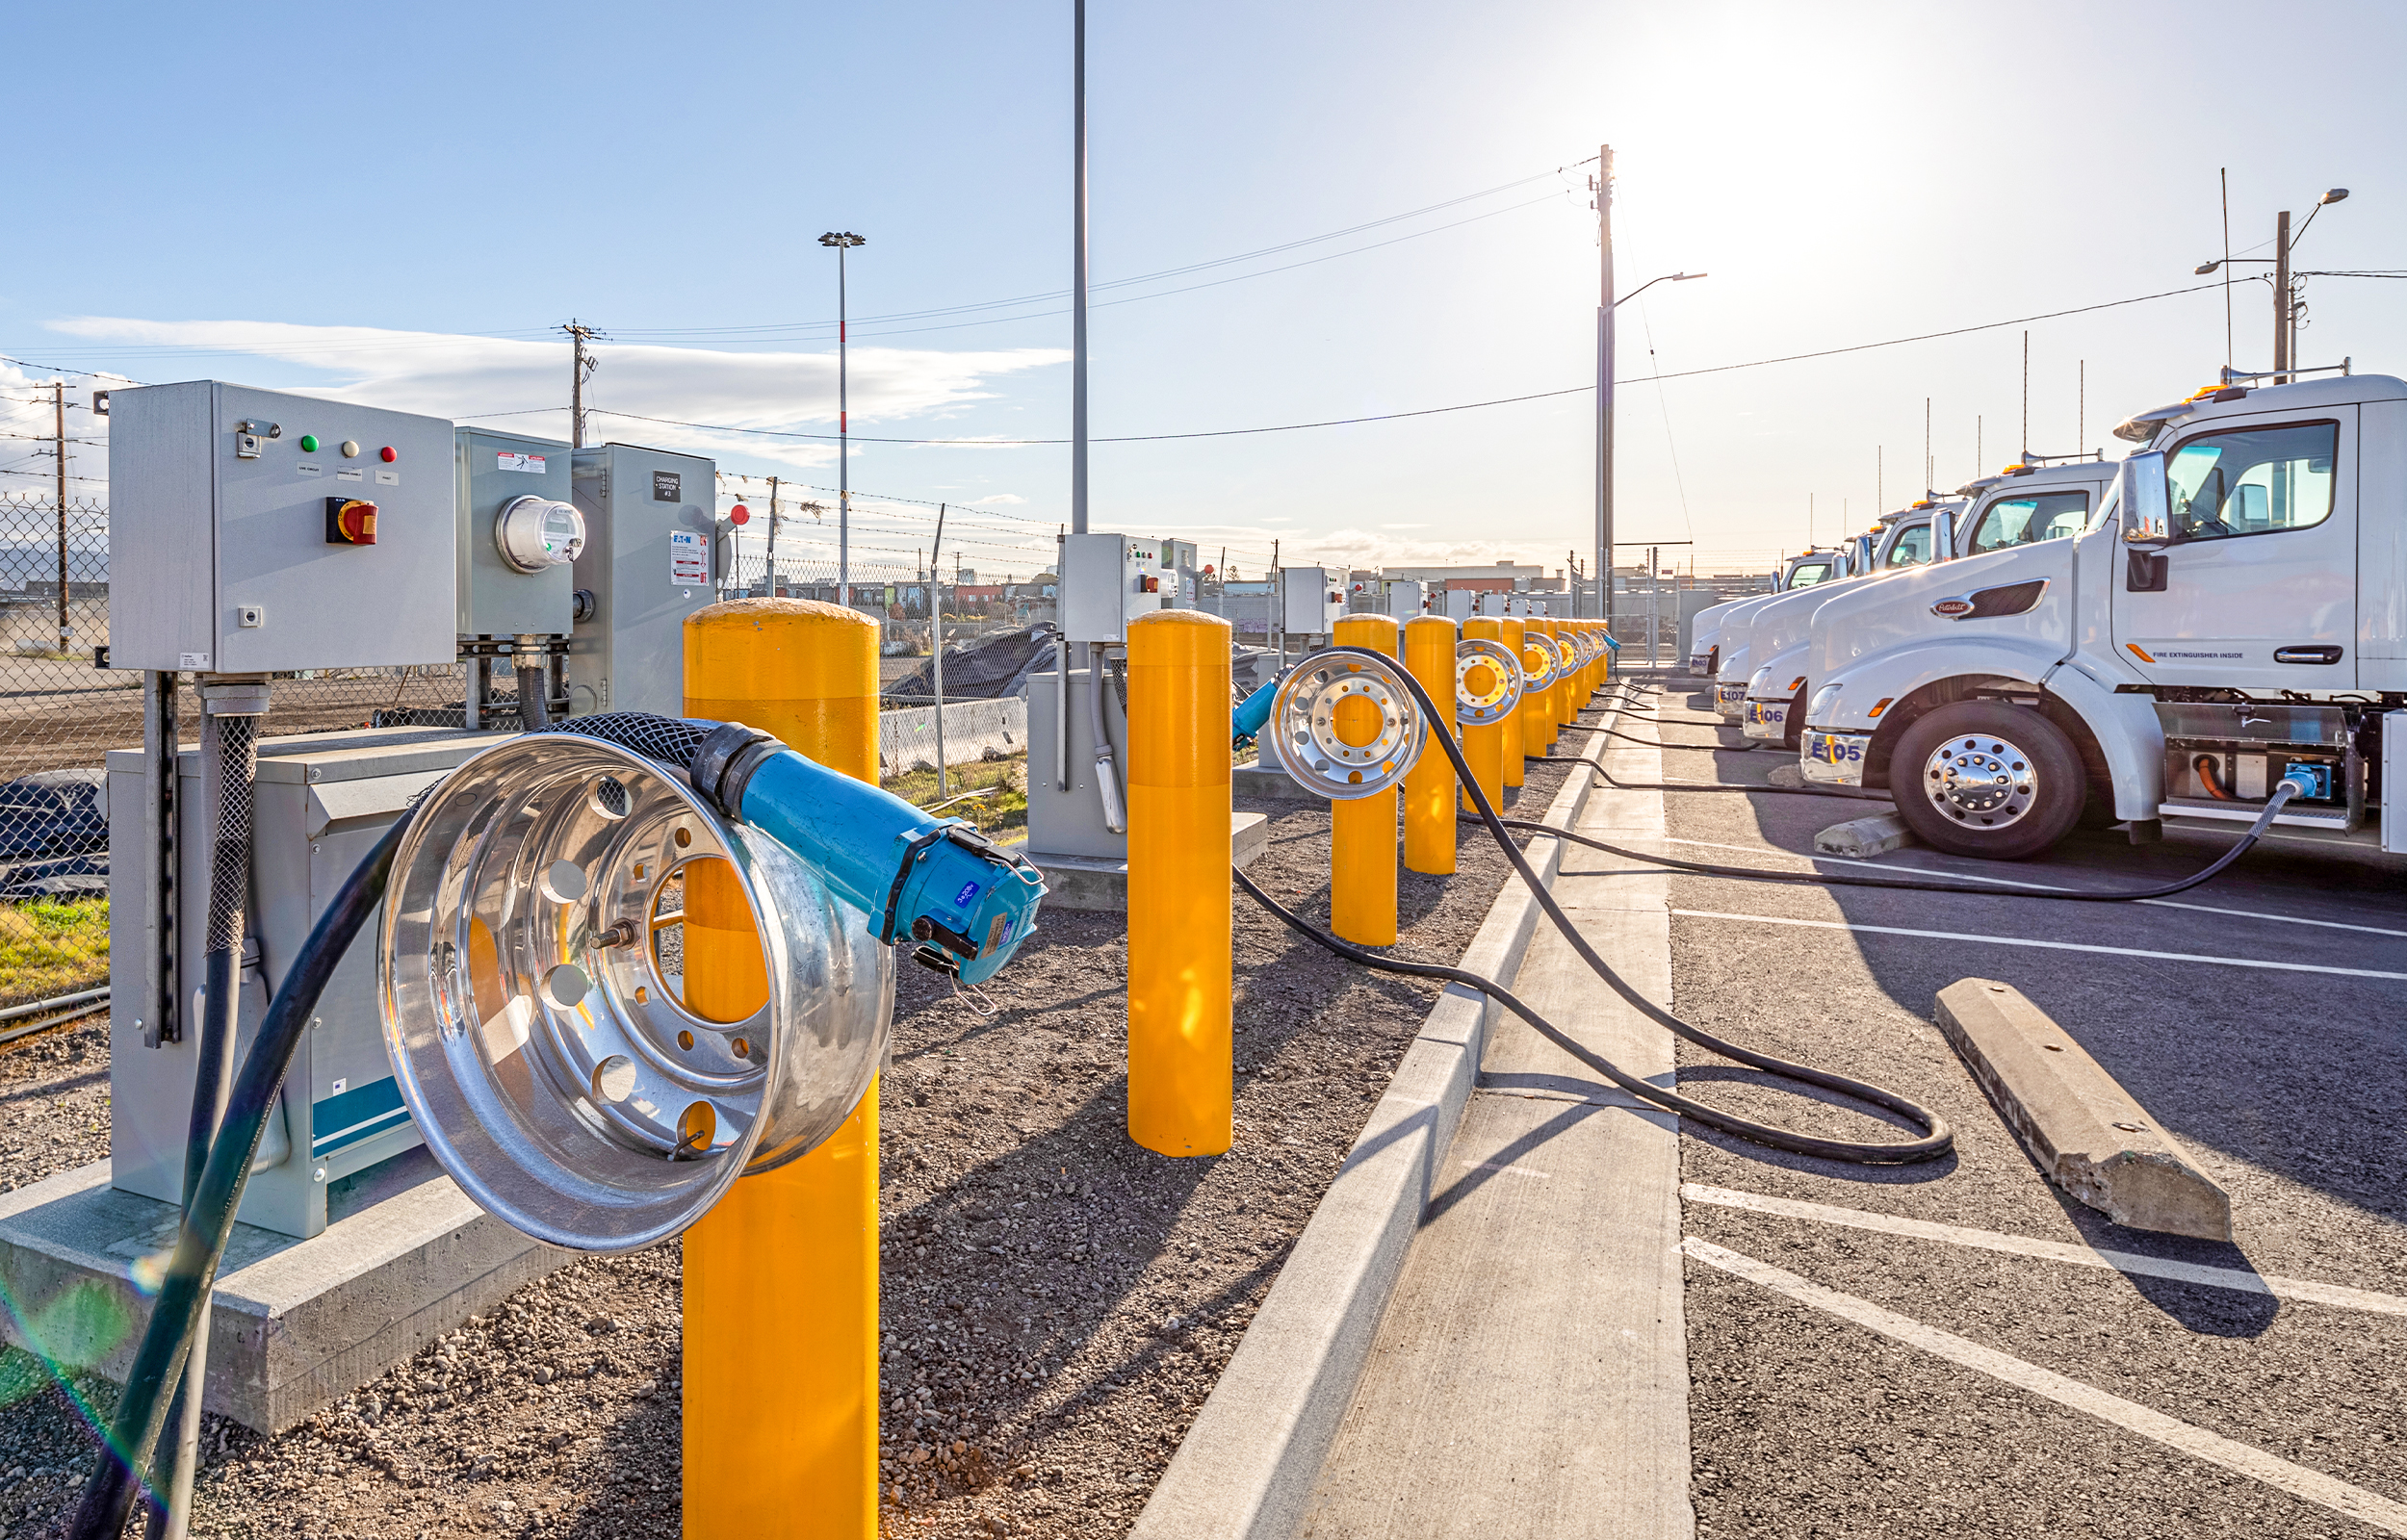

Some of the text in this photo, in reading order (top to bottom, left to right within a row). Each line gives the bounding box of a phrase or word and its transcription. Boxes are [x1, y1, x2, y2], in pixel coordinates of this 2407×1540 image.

[656, 475, 679, 484] CHARGING
[659, 482, 677, 491] STATION
[674, 535, 691, 544] EATON
[1938, 603, 1966, 612] Peterbilt
[1721, 690, 1746, 701] E107
[1750, 709, 1783, 722] E106
[1812, 741, 1861, 761] E105
